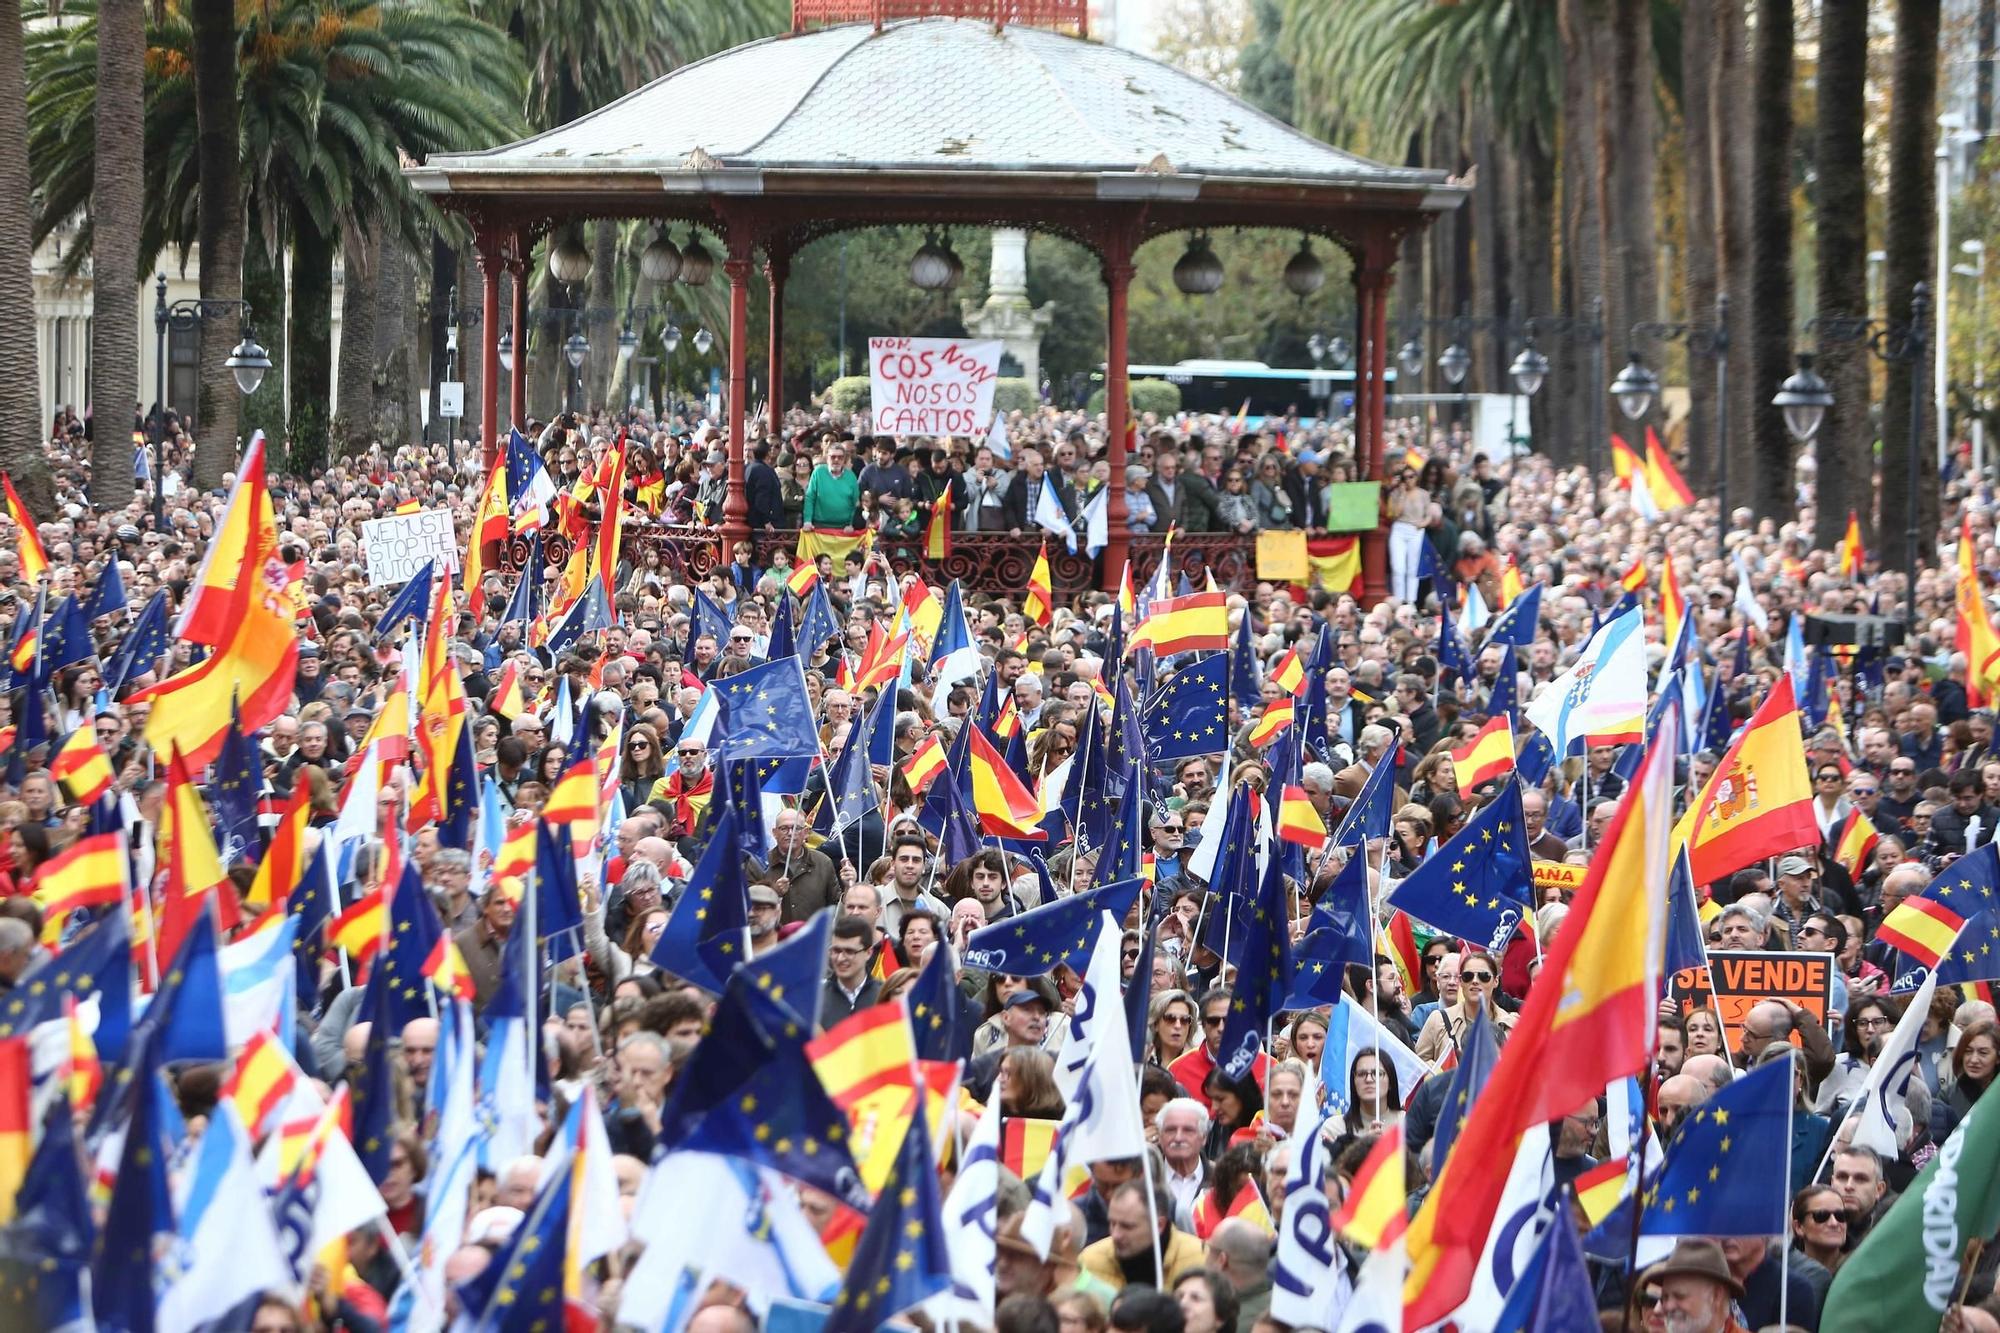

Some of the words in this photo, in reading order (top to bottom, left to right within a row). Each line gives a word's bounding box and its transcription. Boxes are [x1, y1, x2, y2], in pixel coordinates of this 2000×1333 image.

[880, 351, 934, 381] COS
[941, 344, 998, 383] NON
[896, 381, 978, 405] NOSOS
[366, 520, 395, 542] WE
[395, 512, 448, 538] MUST
[369, 536, 419, 562] STOP
[421, 531, 452, 554] THE
[1677, 962, 1714, 989] SE
[1722, 959, 1825, 991] VENDE
